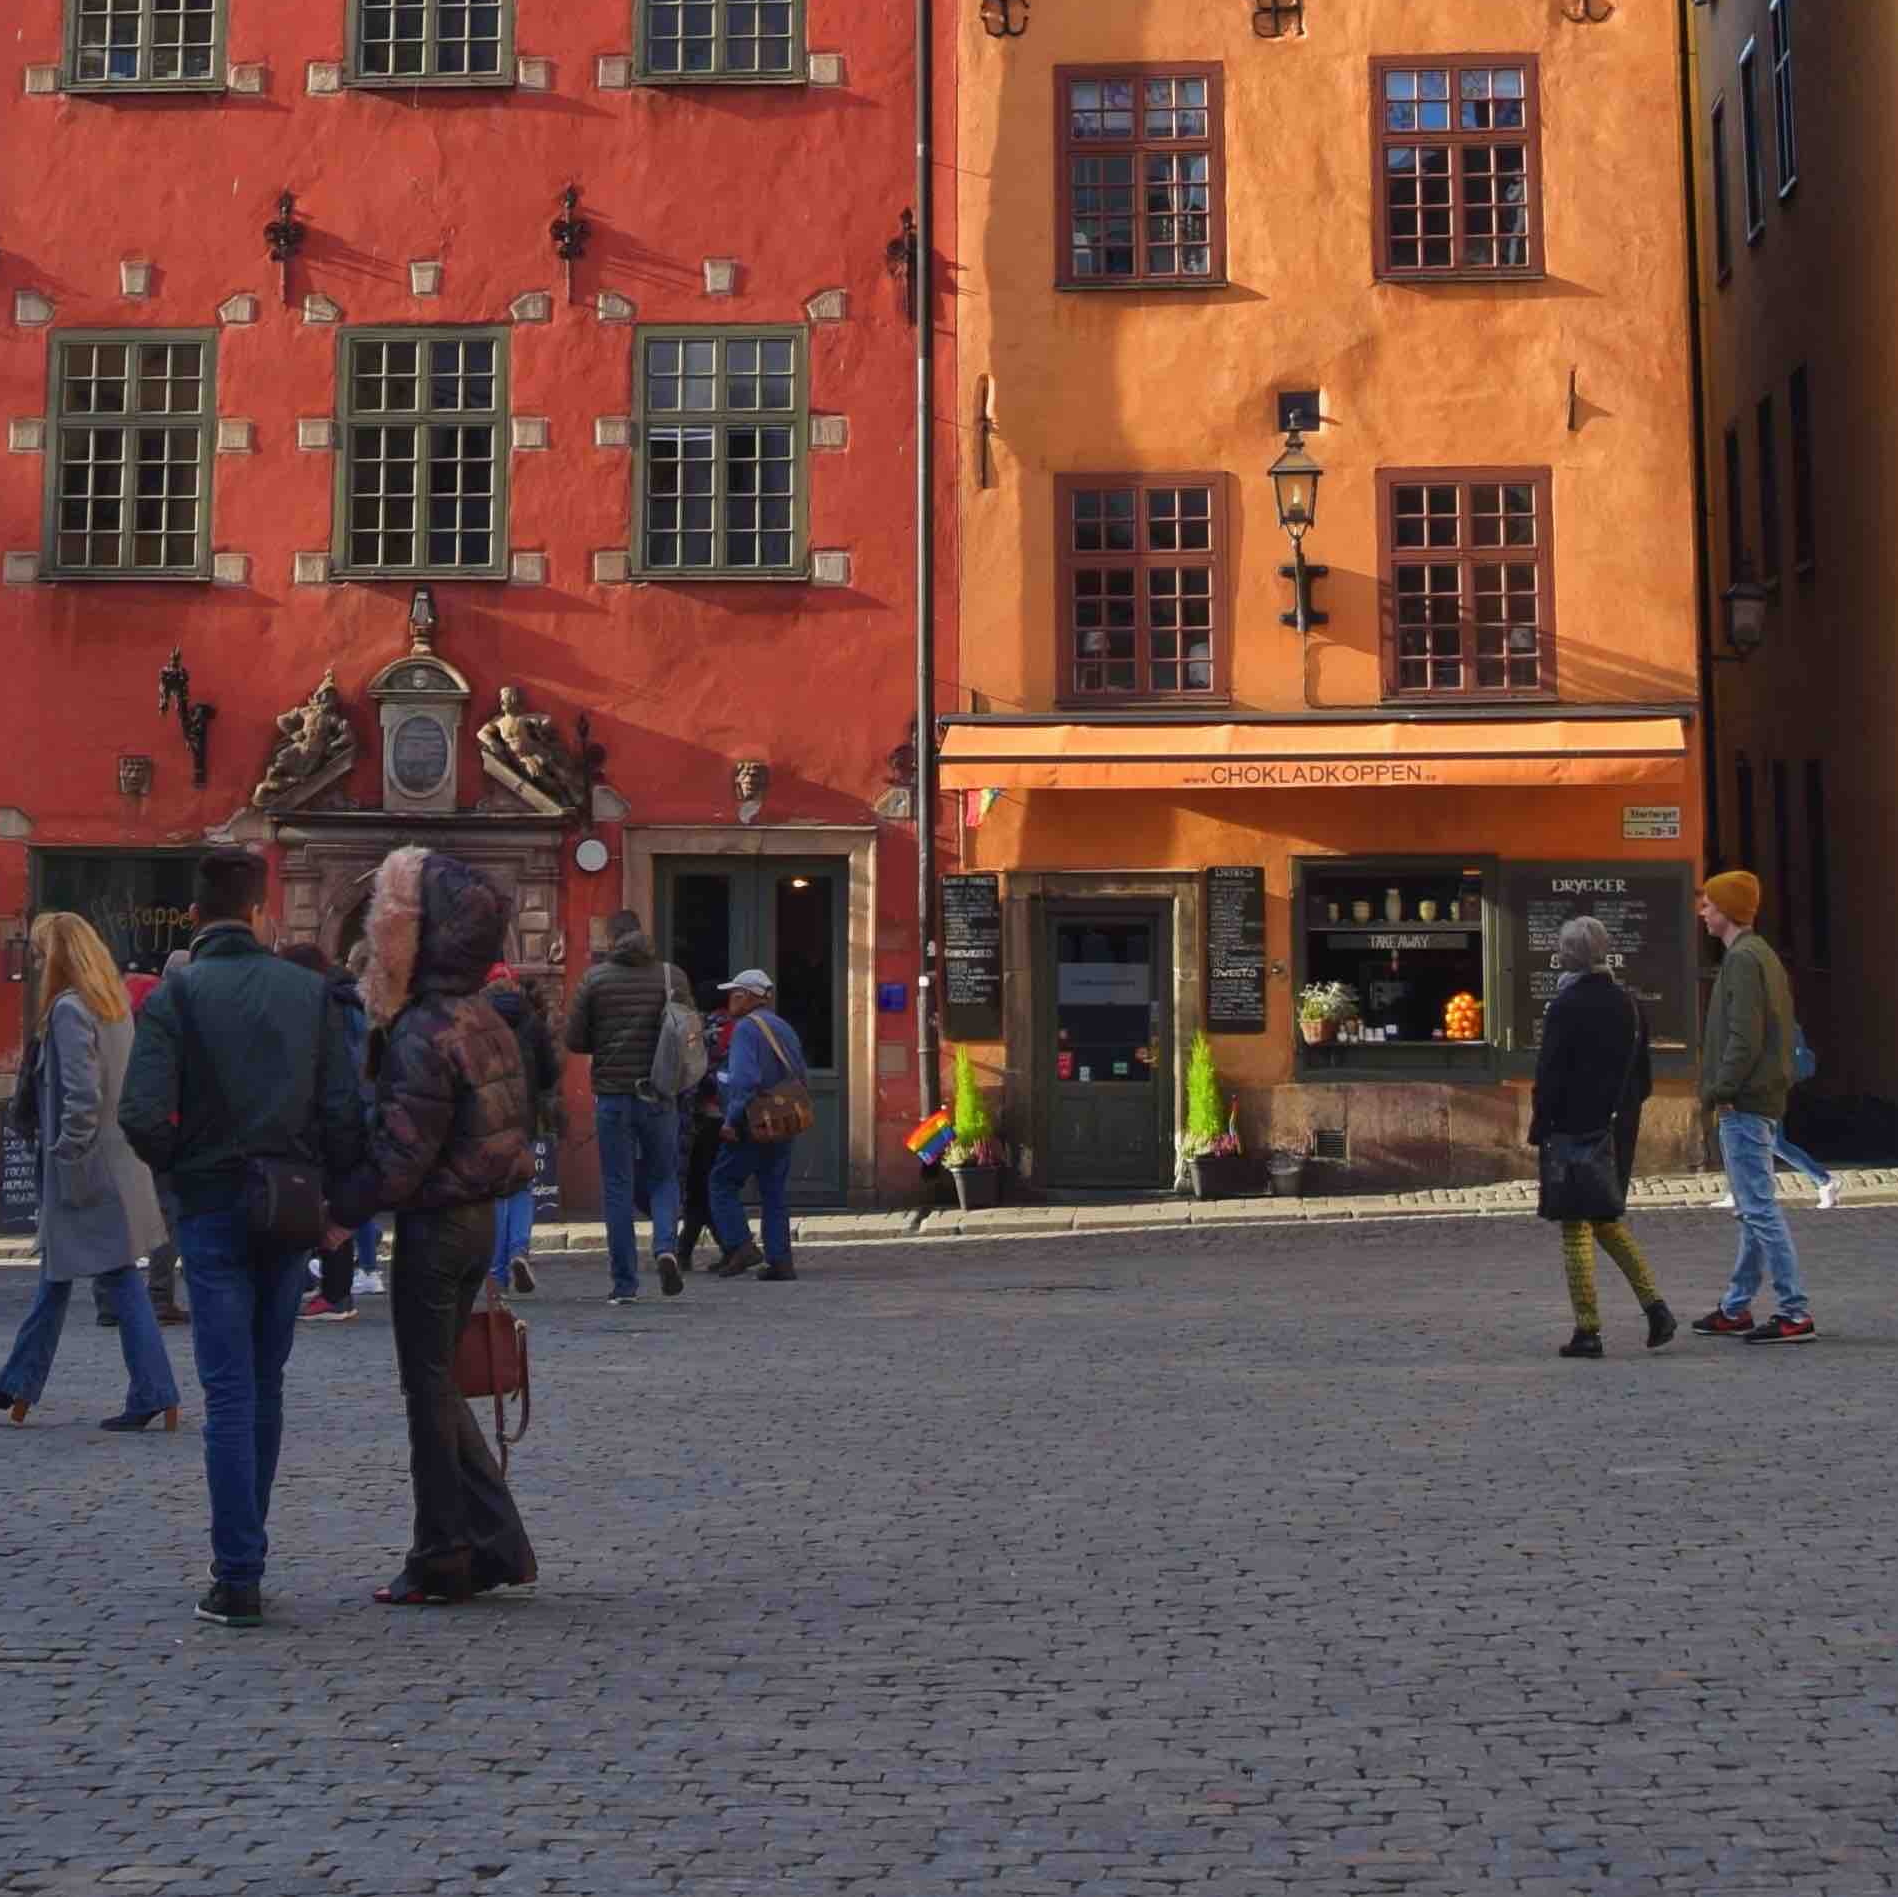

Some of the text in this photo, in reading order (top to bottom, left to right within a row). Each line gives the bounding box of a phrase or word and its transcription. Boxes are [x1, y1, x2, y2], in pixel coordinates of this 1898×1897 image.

[1551, 878, 1627, 895] DRYCKER
[1370, 934, 1430, 949] TAKE AWAY
